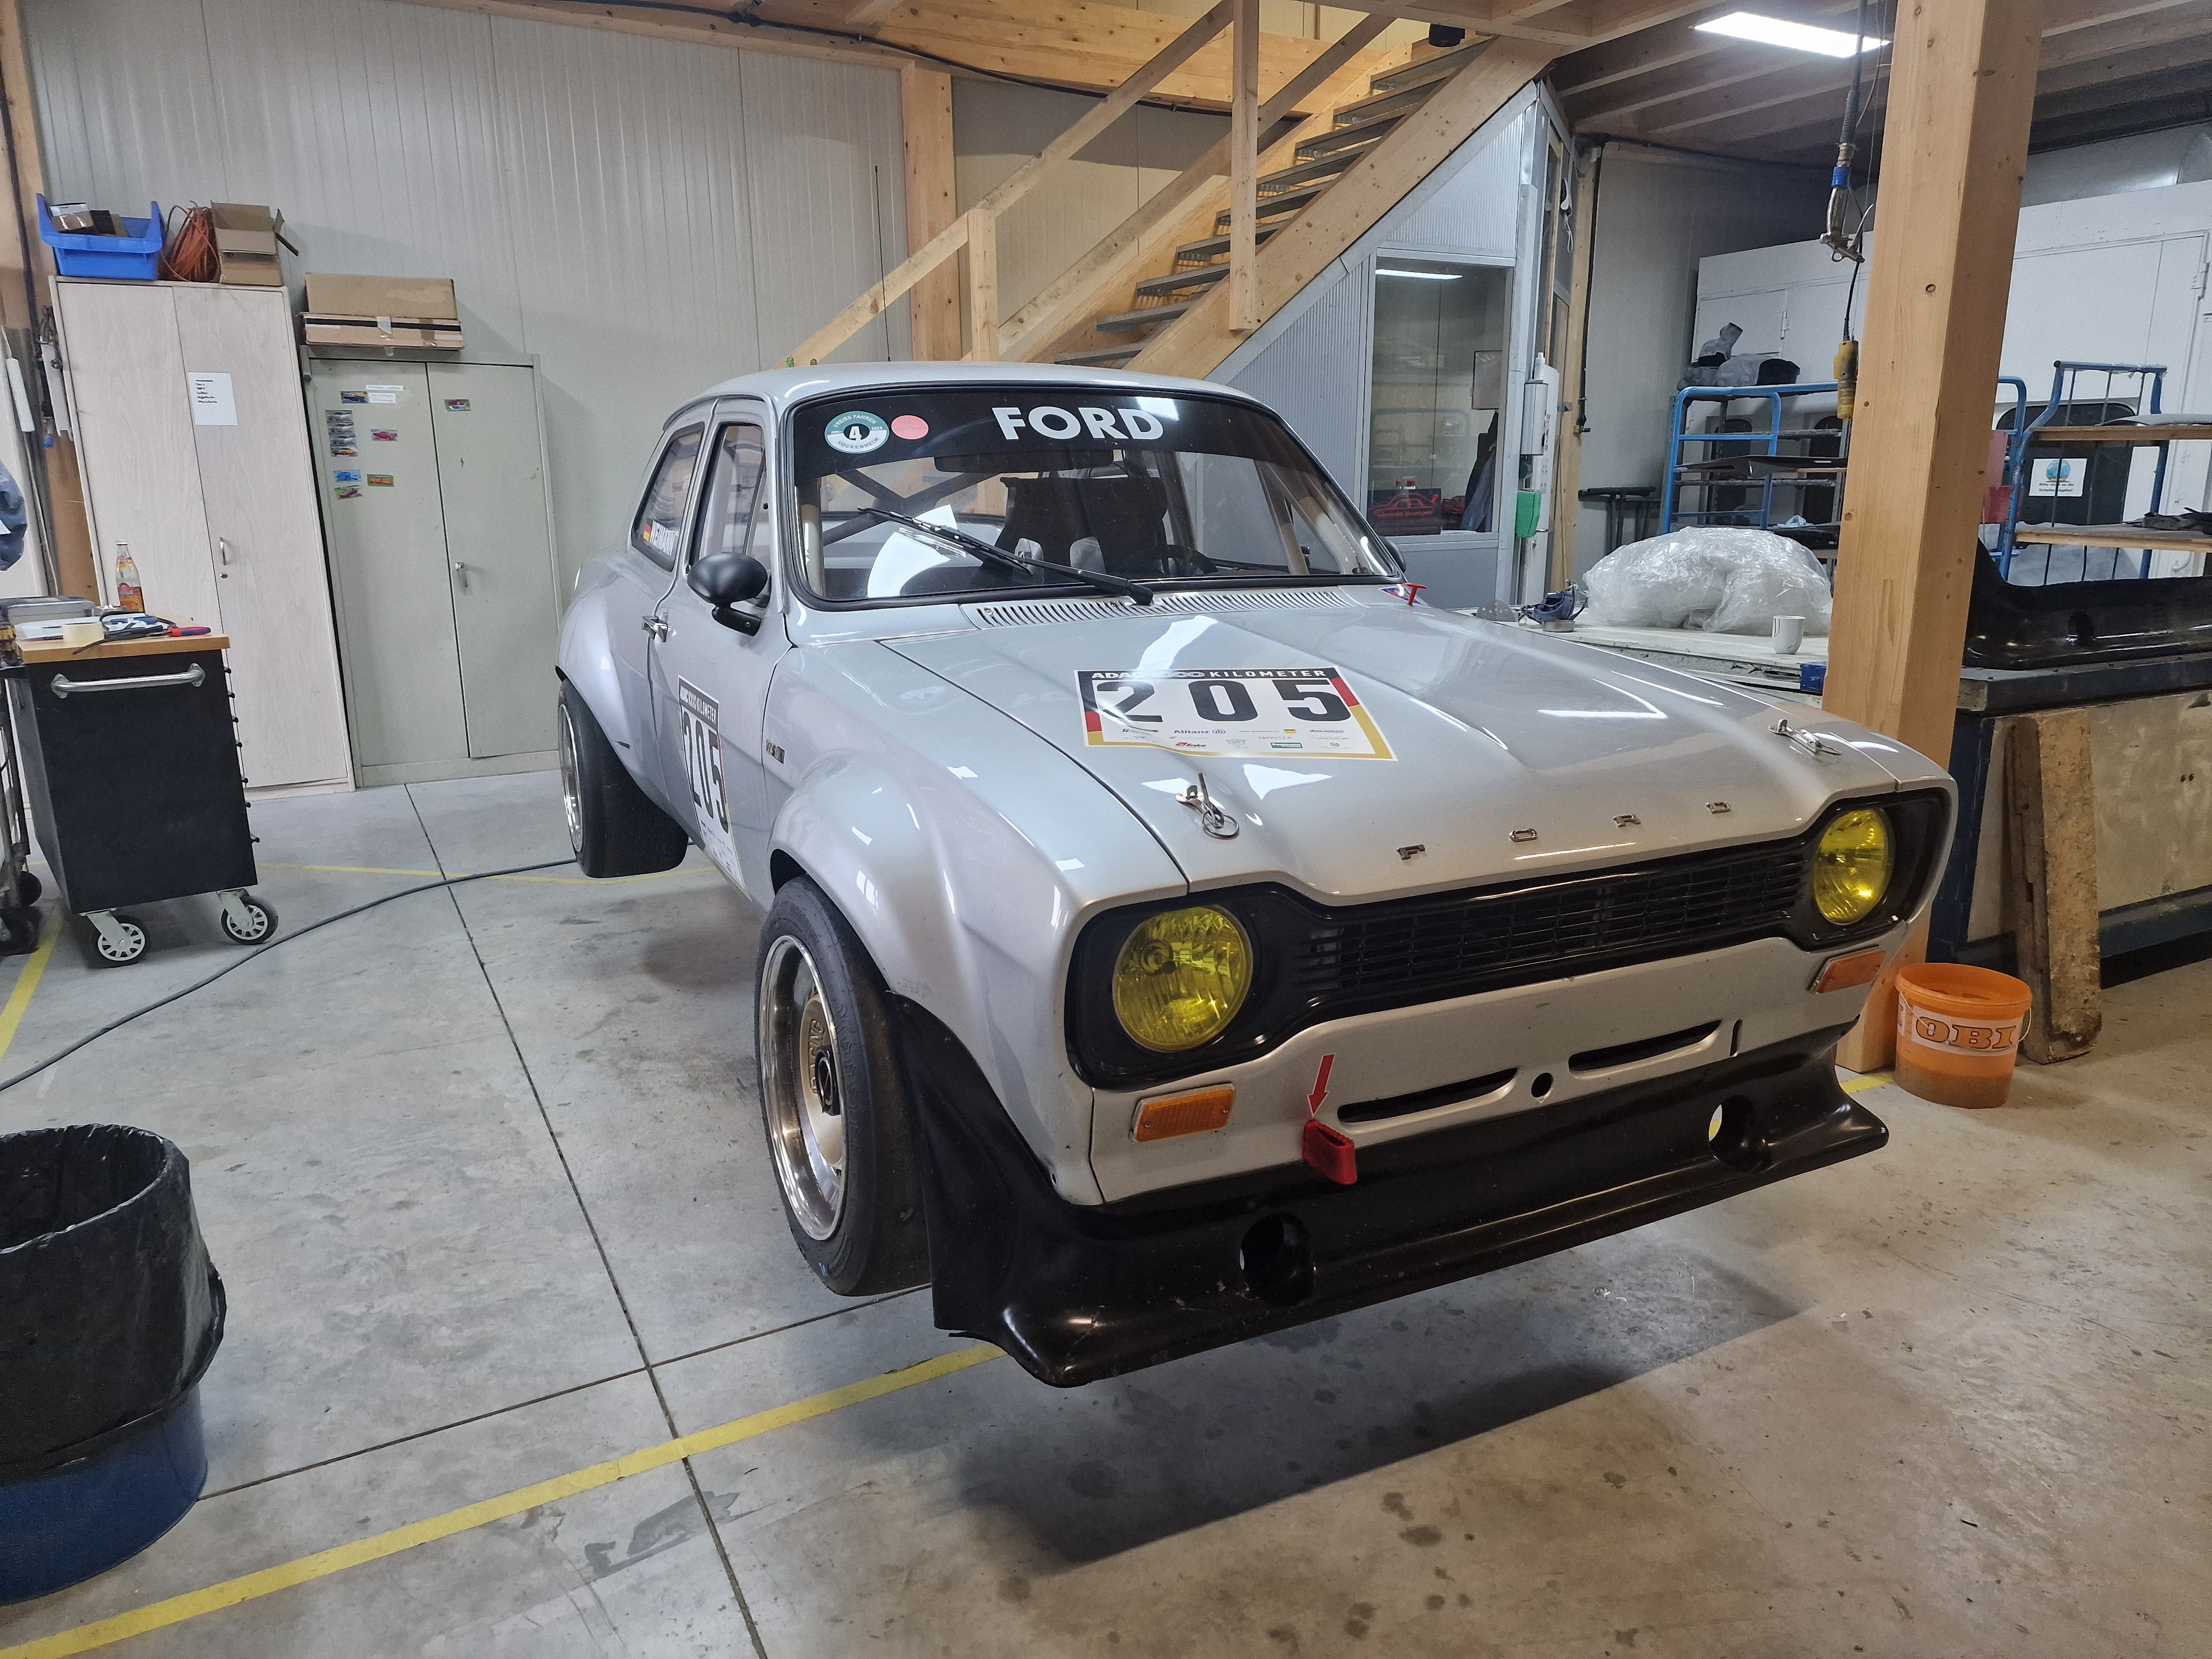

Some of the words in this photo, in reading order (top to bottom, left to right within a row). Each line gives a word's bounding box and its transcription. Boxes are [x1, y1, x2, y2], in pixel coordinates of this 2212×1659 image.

[833, 415, 852, 428] FREIES
[853, 414, 877, 424] FAHREN
[849, 426, 862, 441] 4
[992, 406, 1164, 440] FORD
[837, 437, 880, 449] HOCKENHEIM
[1209, 669, 1327, 678] KILOMETER
[697, 697, 716, 724] KILOMETER
[1096, 680, 1352, 723] 205
[683, 711, 729, 834] 205
[1916, 1015, 2017, 1050] OBI
